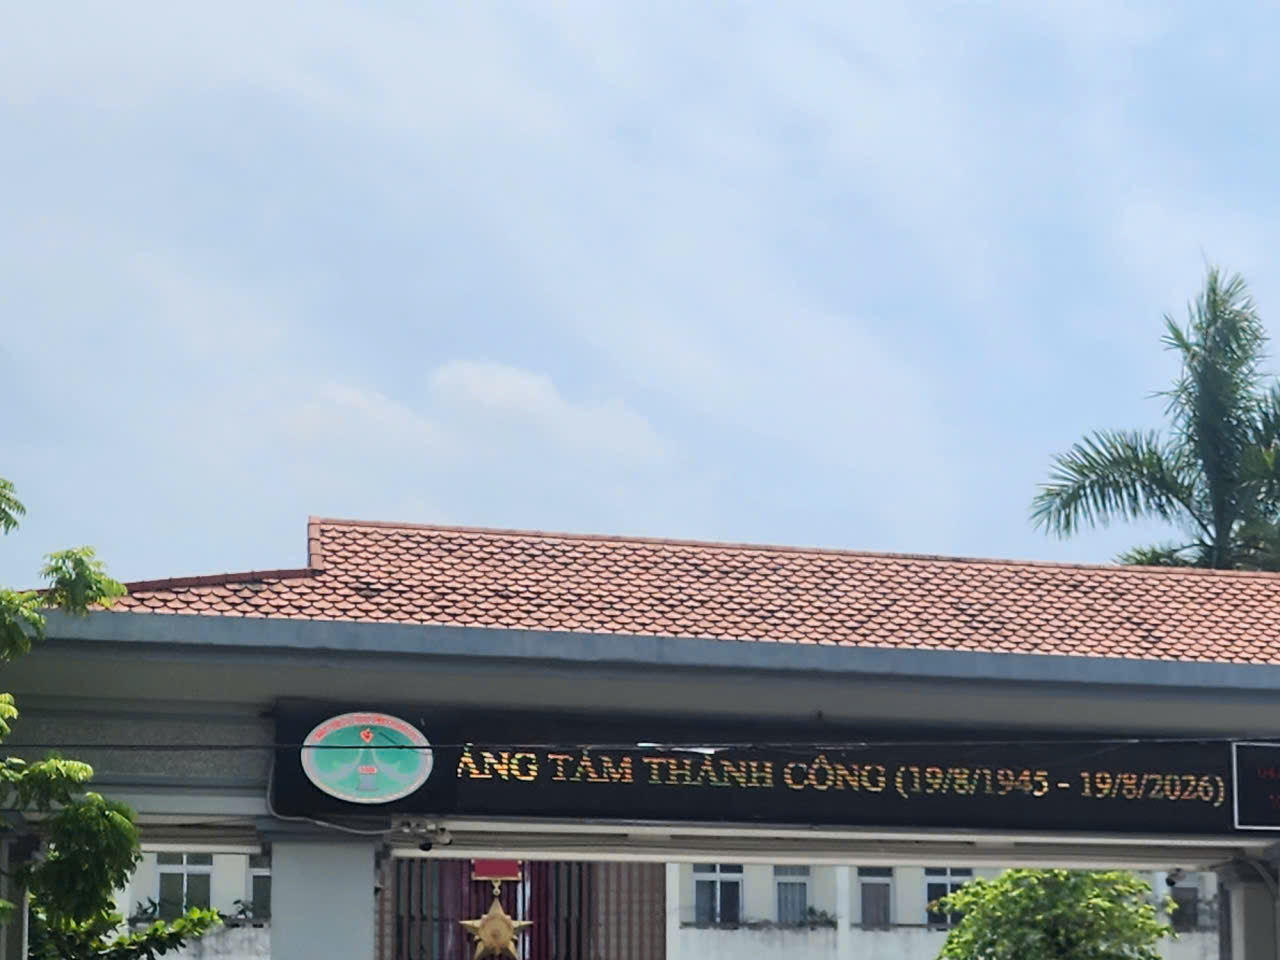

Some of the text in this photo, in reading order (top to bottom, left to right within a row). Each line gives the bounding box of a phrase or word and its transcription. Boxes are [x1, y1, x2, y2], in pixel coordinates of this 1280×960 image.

[784, 753, 886, 792] CÔNG
[895, 765, 1049, 799] (19/8/1945
[1080, 771, 1225, 807] 19/8/2026)
